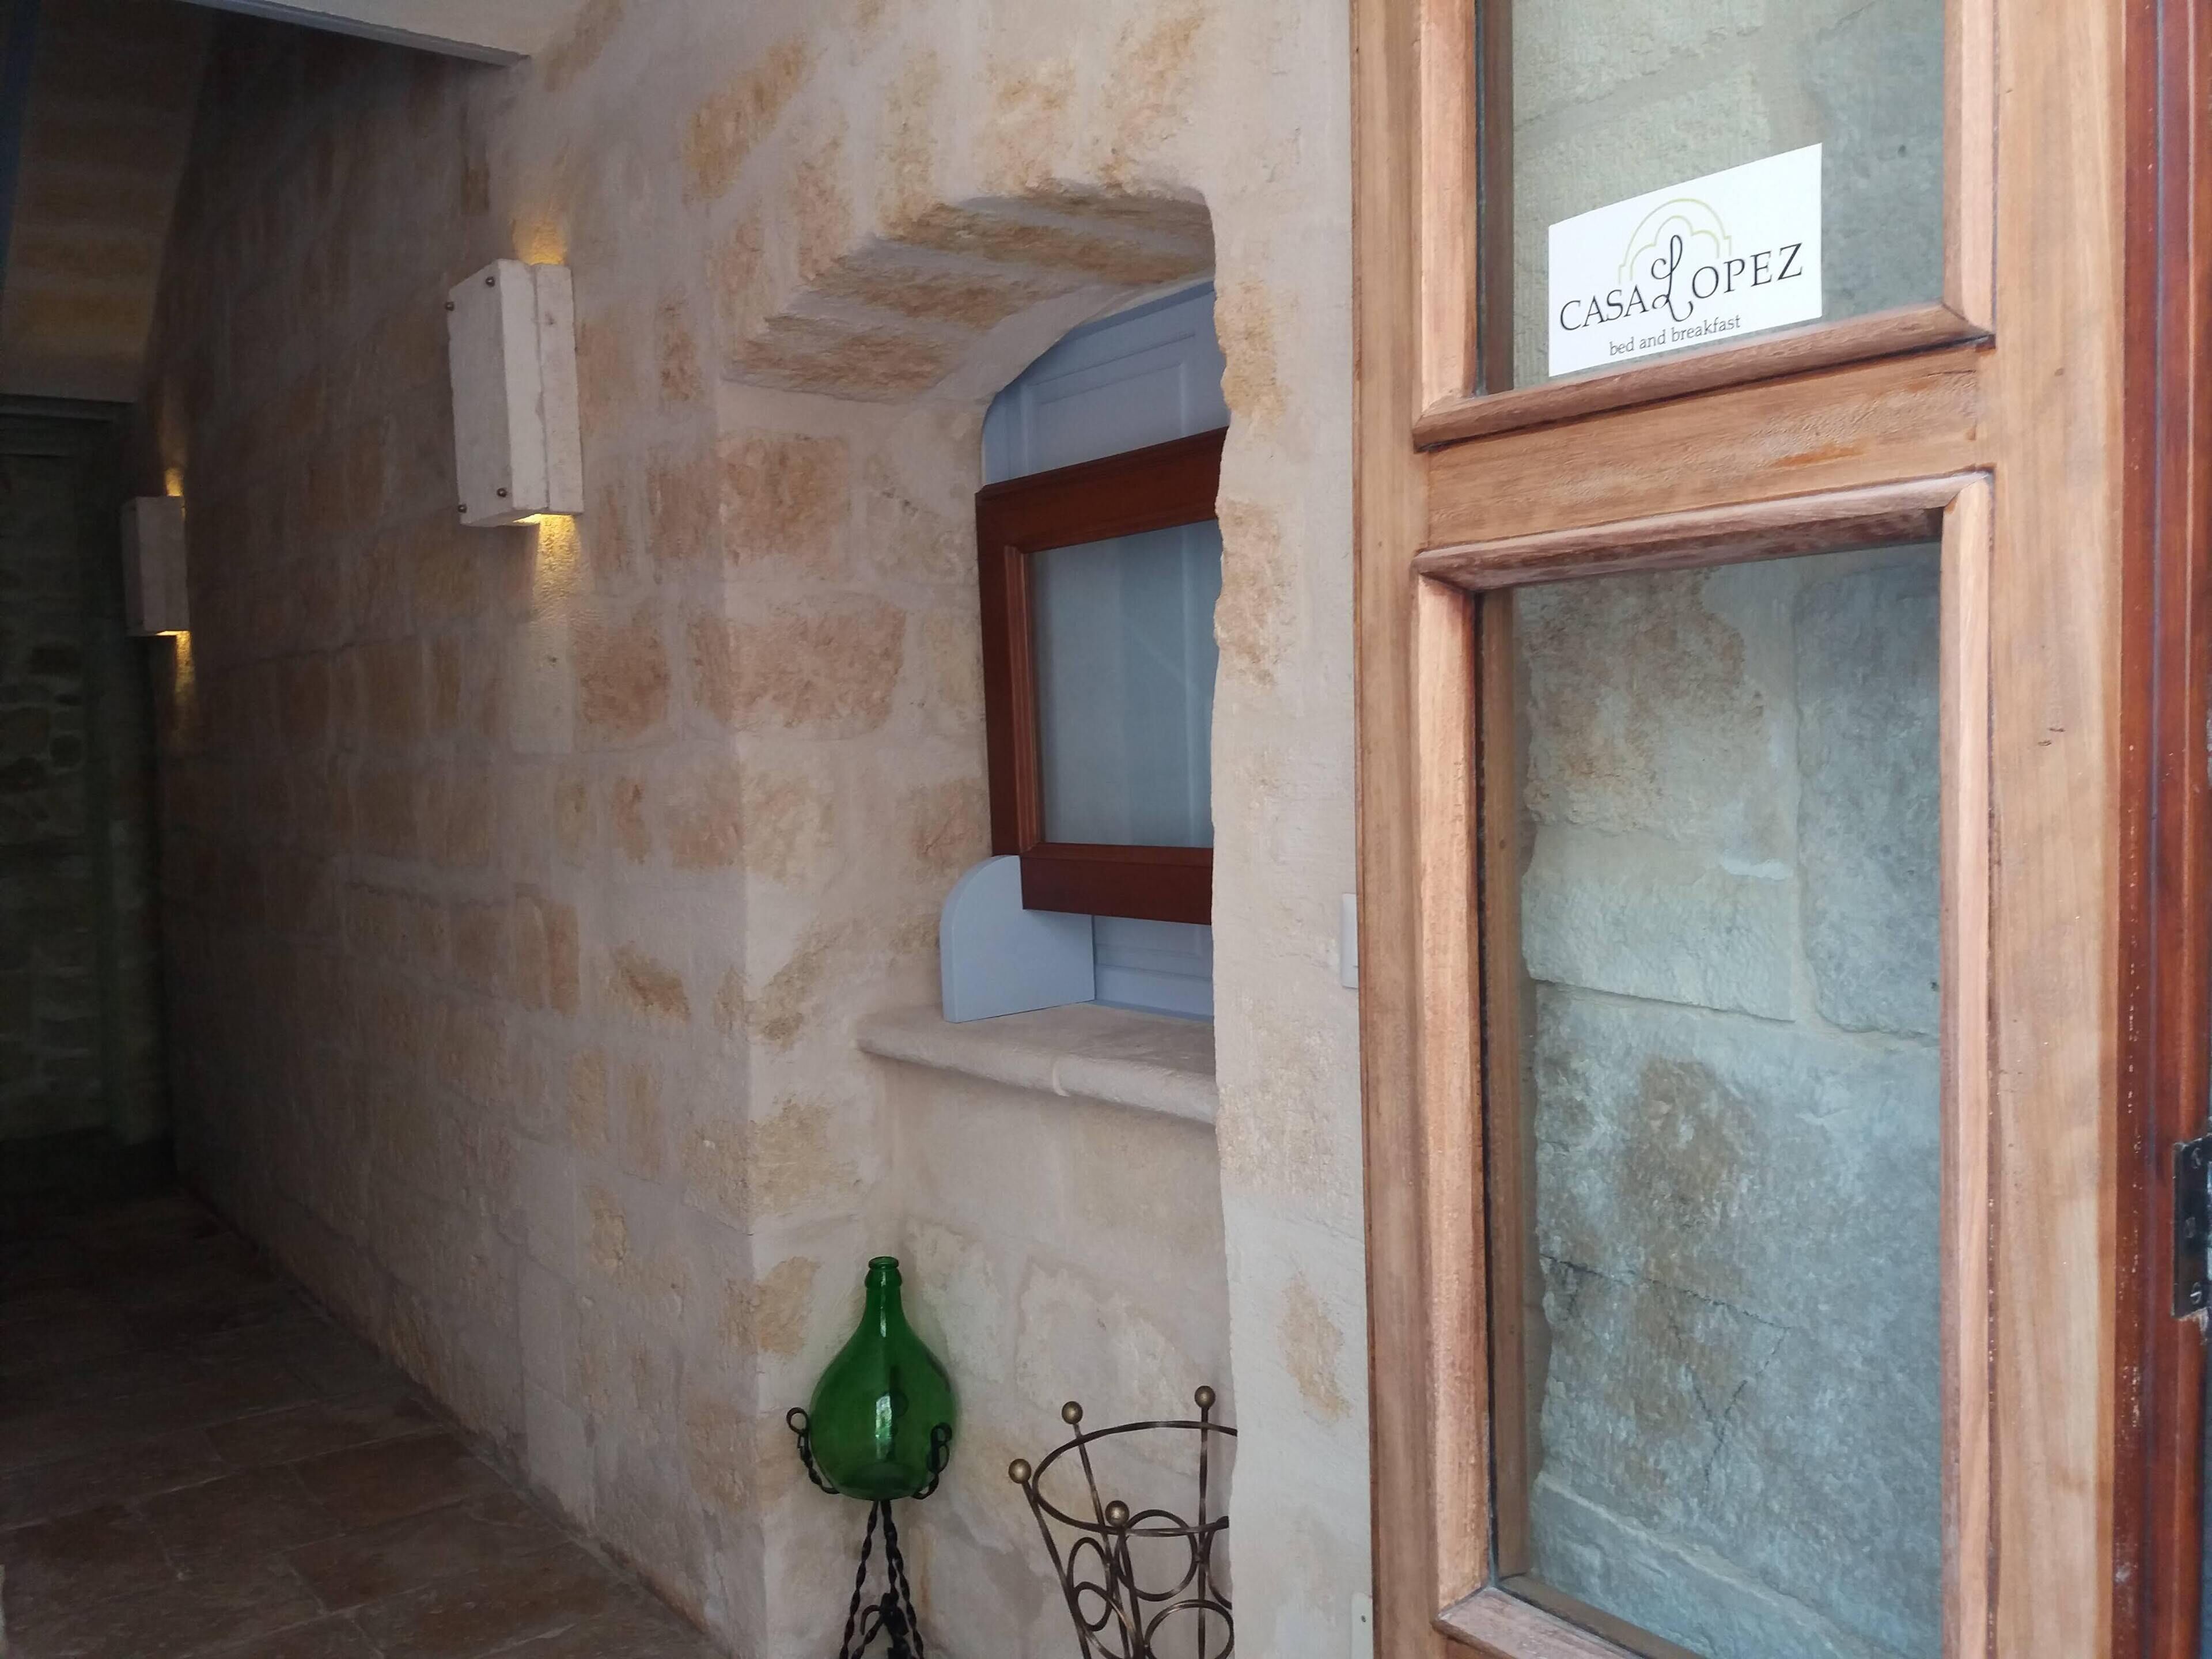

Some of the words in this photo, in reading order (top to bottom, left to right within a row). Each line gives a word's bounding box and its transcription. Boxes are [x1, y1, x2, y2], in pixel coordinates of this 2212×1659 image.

[1559, 285, 1648, 331] CASA
[1650, 234, 1803, 323] LOPEZ
[1609, 336, 1635, 356] bed
[1639, 332, 1666, 350] and
[1671, 314, 1741, 342] breakfast
